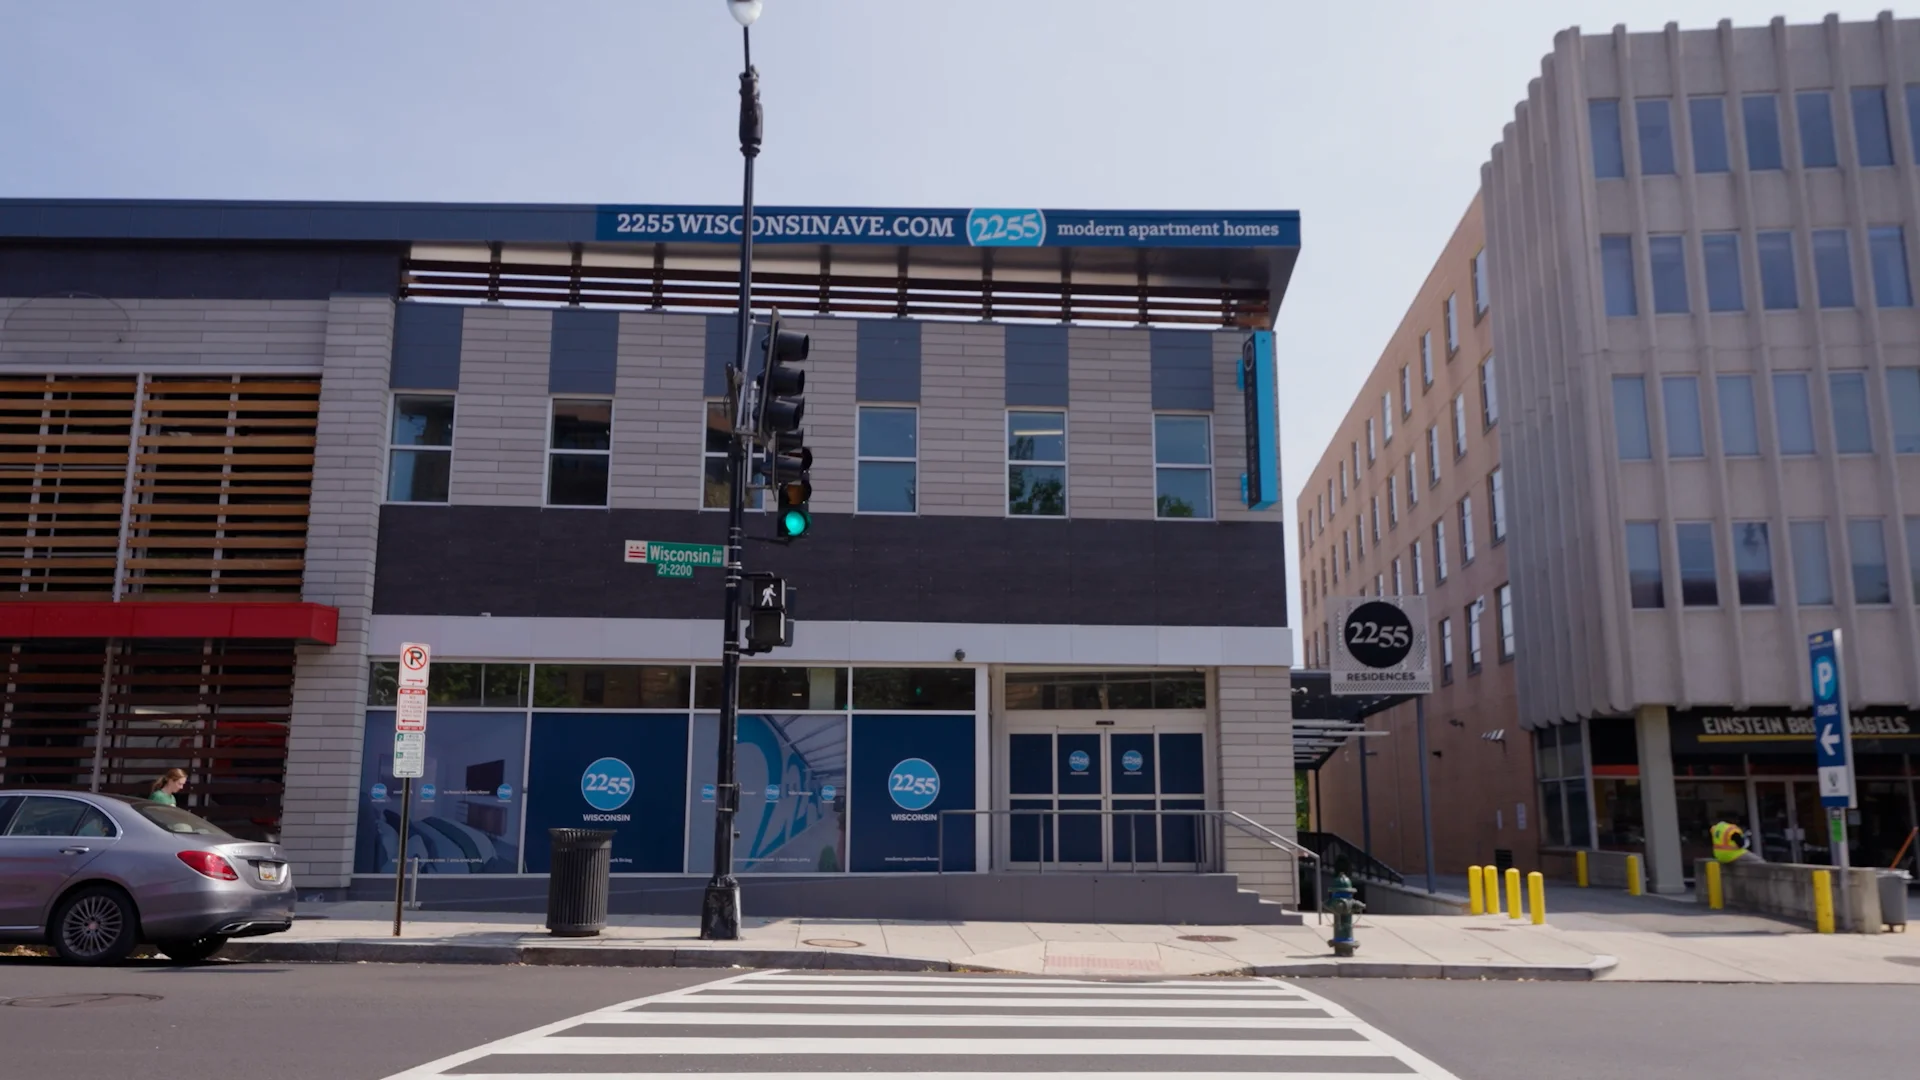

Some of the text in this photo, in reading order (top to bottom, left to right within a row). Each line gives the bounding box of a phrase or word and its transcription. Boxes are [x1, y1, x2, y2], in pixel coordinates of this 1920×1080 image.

[972, 212, 1041, 242] 2255
[1057, 220, 1279, 241] modern apartment homes
[649, 545, 711, 563] Wisconsin
[711, 556, 722, 564] NW
[658, 564, 693, 576] 21-2200
[1349, 621, 1409, 648] 2255
[1347, 672, 1416, 681] RESIDENCES
[1817, 661, 1833, 697] P
[1702, 716, 1784, 734] EINSTEIN
[1850, 715, 1911, 734] AGELS
[585, 773, 631, 795] 2255
[892, 773, 936, 795] 2255
